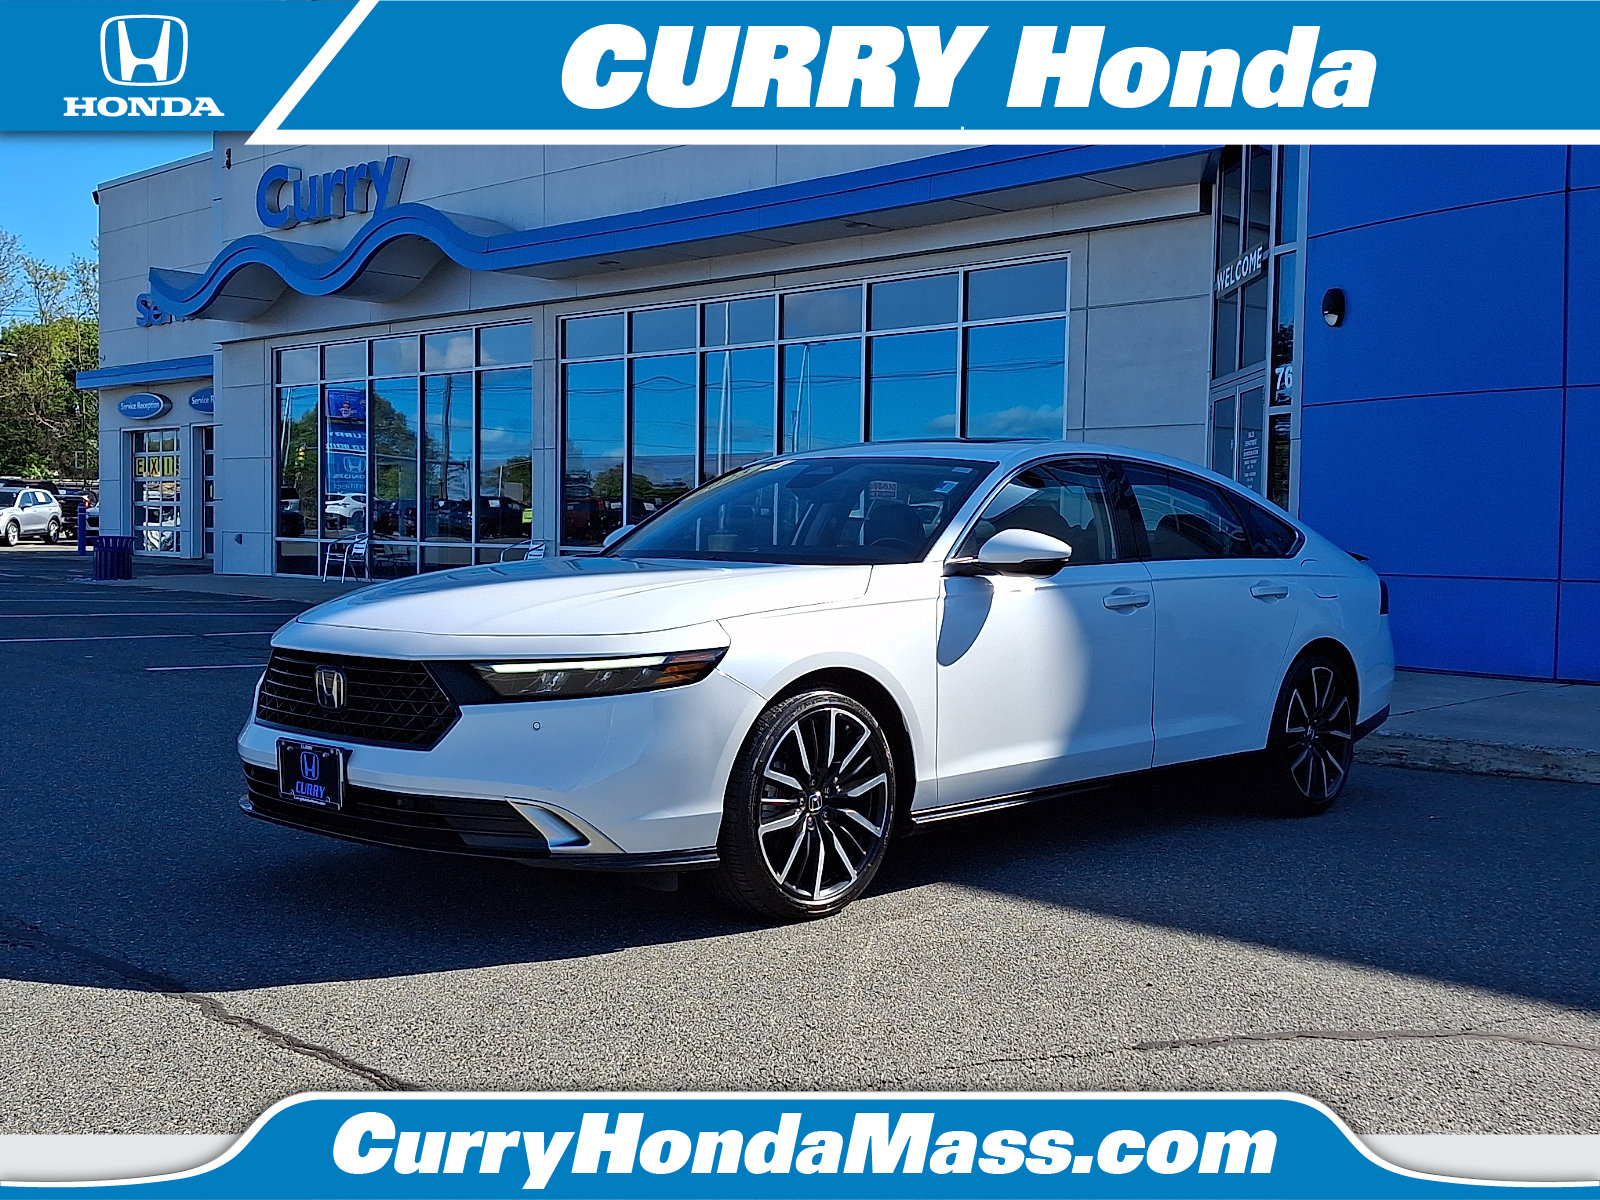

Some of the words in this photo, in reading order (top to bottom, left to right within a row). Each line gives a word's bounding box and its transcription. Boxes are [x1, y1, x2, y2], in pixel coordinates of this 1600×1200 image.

[256, 155, 405, 229] Curry
[1216, 245, 1262, 293] WELCOME
[120, 402, 136, 410] Service
[136, 400, 160, 411] Reception
[191, 396, 209, 405] Service
[295, 780, 326, 799] CURRY
